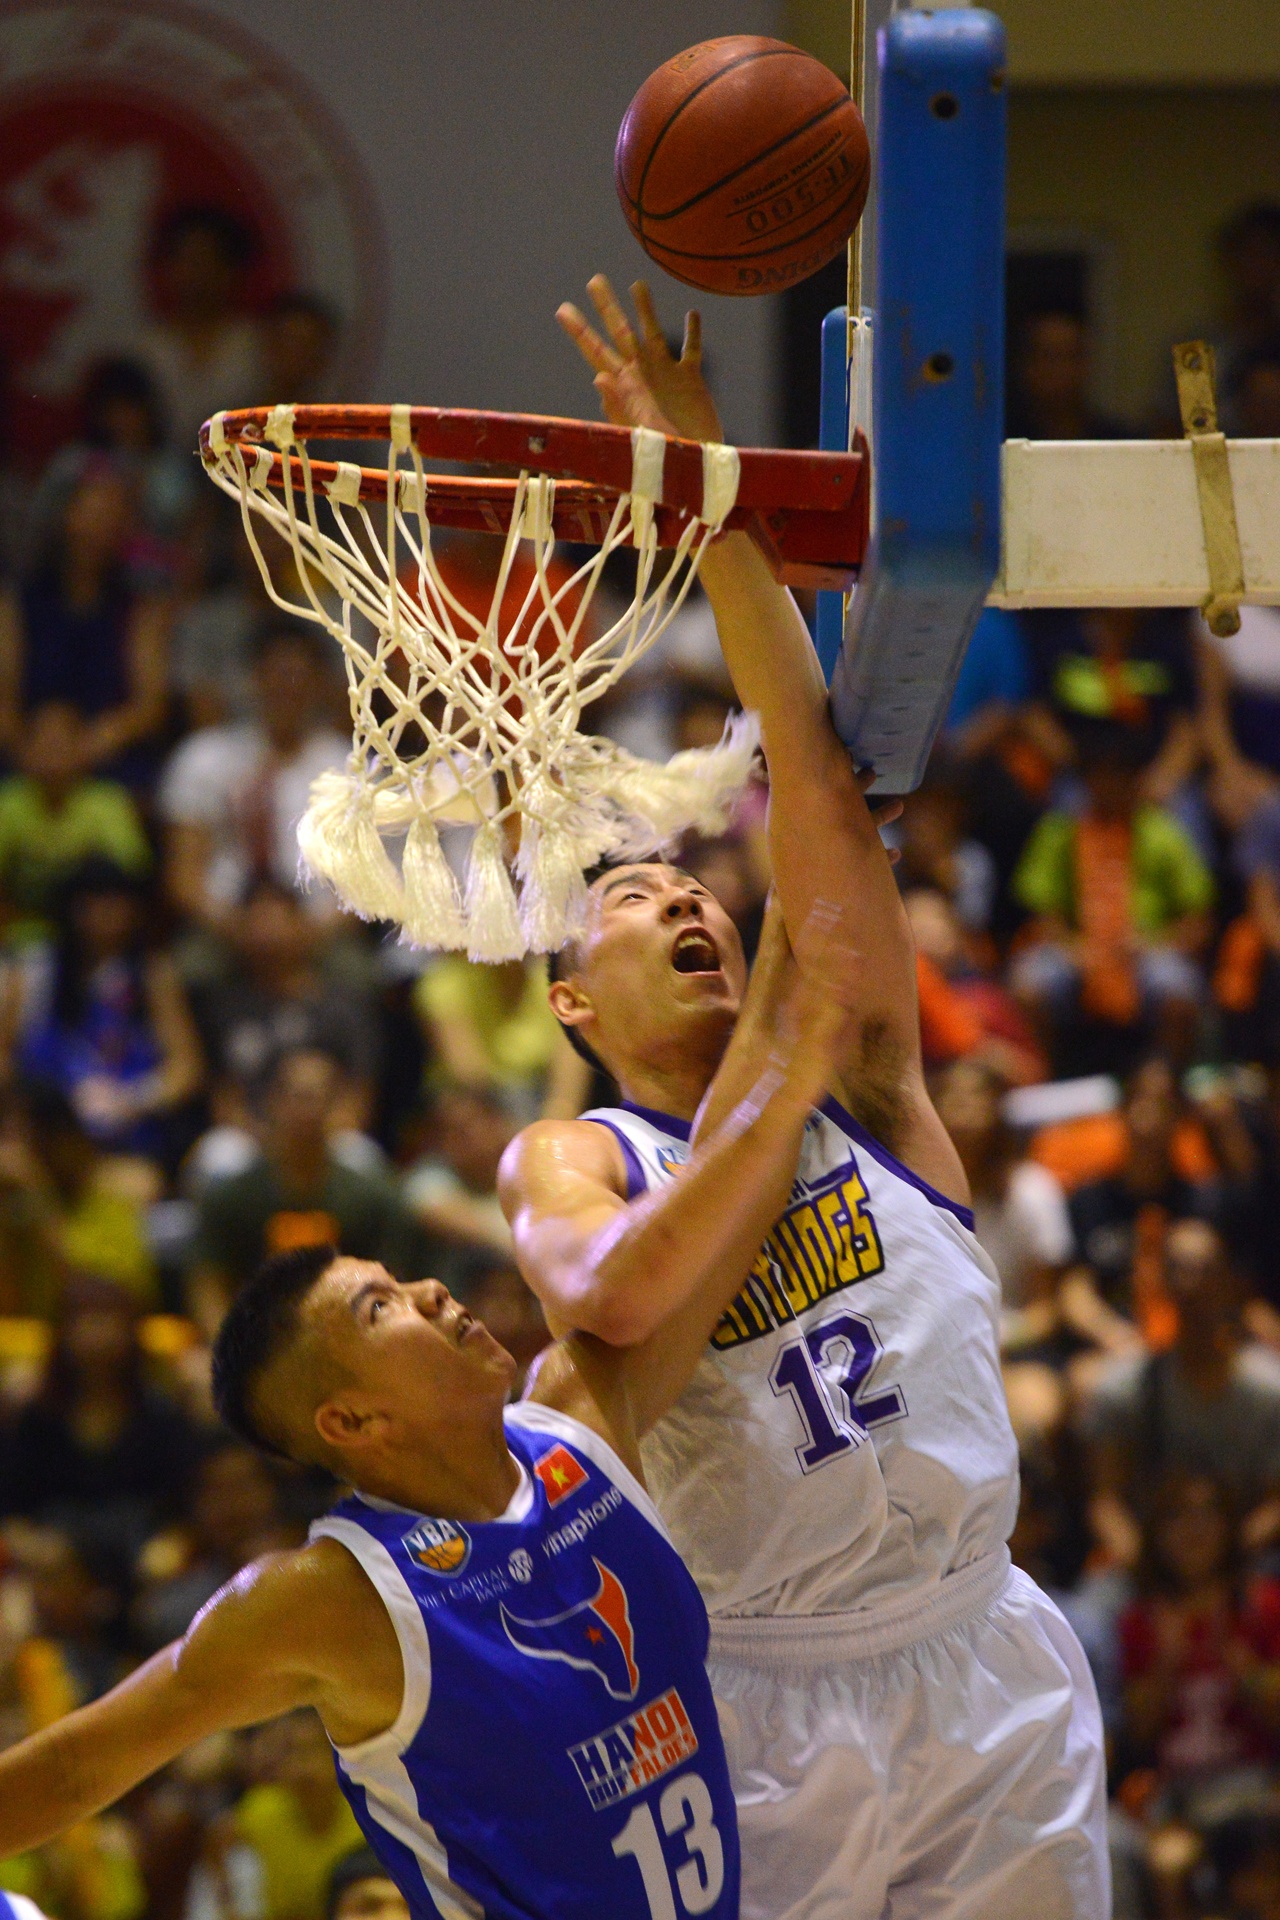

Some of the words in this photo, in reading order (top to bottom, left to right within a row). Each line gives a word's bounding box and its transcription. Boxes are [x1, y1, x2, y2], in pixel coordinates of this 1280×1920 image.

[768, 1308, 909, 1476] 12
[408, 1518, 458, 1551] VBA
[541, 1486, 623, 1557] vinaphone
[571, 1688, 694, 1785] HANOI
[611, 1772, 724, 1920] 13
